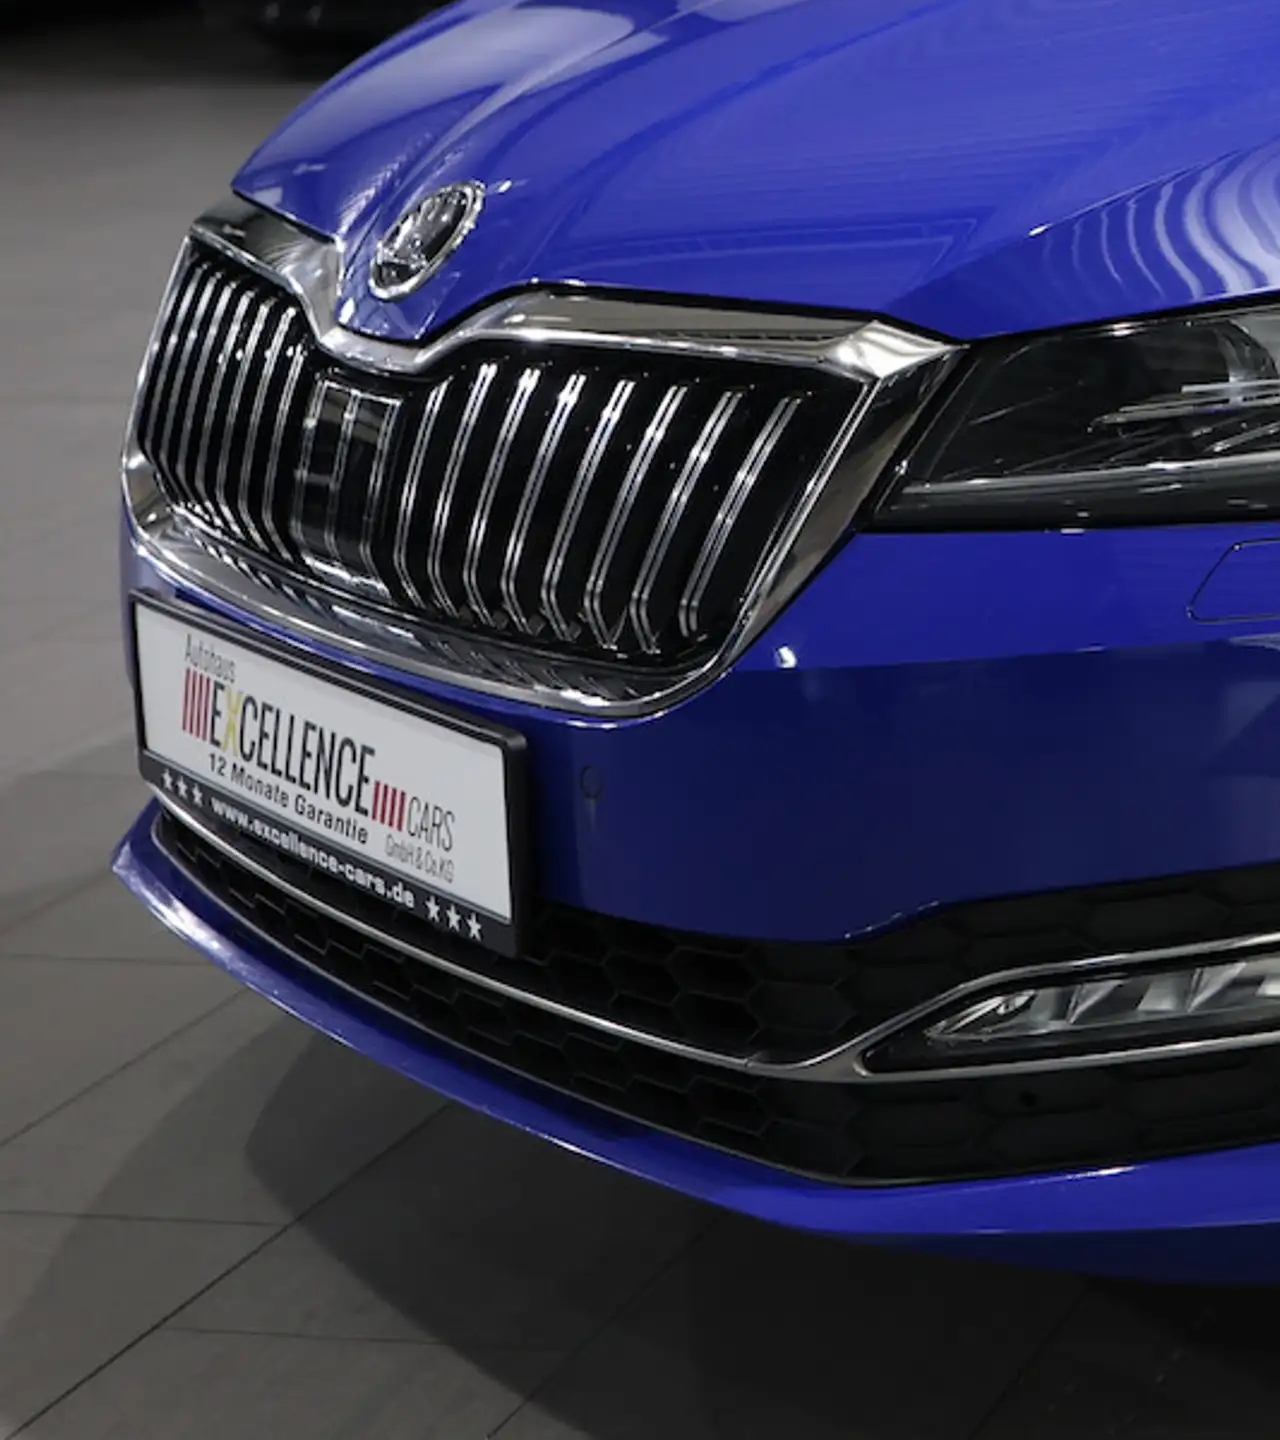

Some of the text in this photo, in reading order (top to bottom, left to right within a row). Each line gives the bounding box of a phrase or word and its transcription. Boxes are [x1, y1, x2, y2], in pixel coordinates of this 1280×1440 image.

[184, 632, 236, 684] Autohaus
[209, 679, 456, 853] EXCELLENCE CARS
[209, 753, 369, 845] 12 Monate Garantie
[210, 797, 415, 909] www.excellence-cars.de
